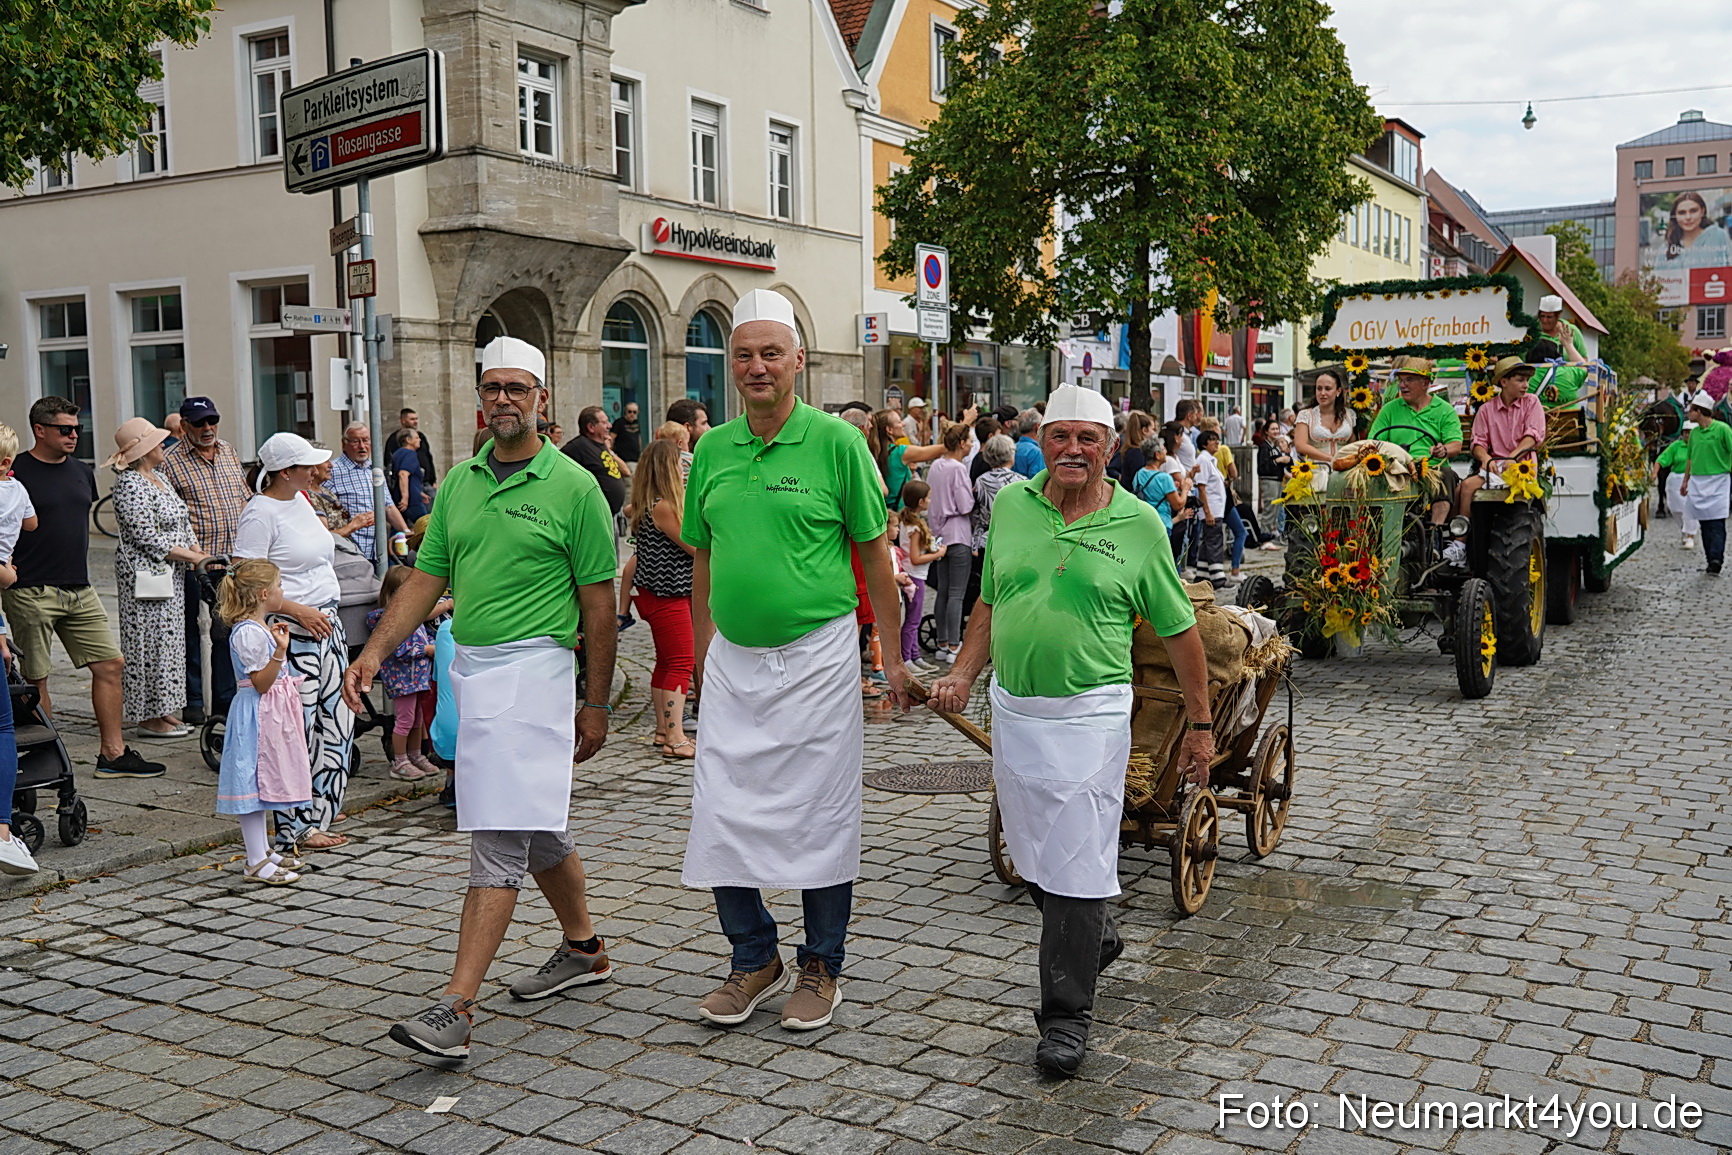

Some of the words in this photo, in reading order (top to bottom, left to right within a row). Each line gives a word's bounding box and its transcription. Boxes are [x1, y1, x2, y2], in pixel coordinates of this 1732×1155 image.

[303, 77, 399, 124] Parkleitsystem
[316, 148, 325, 168] P
[337, 126, 402, 157] Rosengasse
[671, 221, 777, 259] HypoVereinsbank
[926, 290, 941, 301] ZONE
[1350, 319, 1388, 342] OGV
[1395, 314, 1490, 343] Woffenbach
[765, 484, 799, 494] Woffenbach
[781, 476, 800, 486] OGV
[504, 507, 538, 523] Woffenbach
[520, 503, 541, 516] OGV
[1079, 540, 1116, 561] Woffenbach
[1098, 538, 1119, 552] OGV
